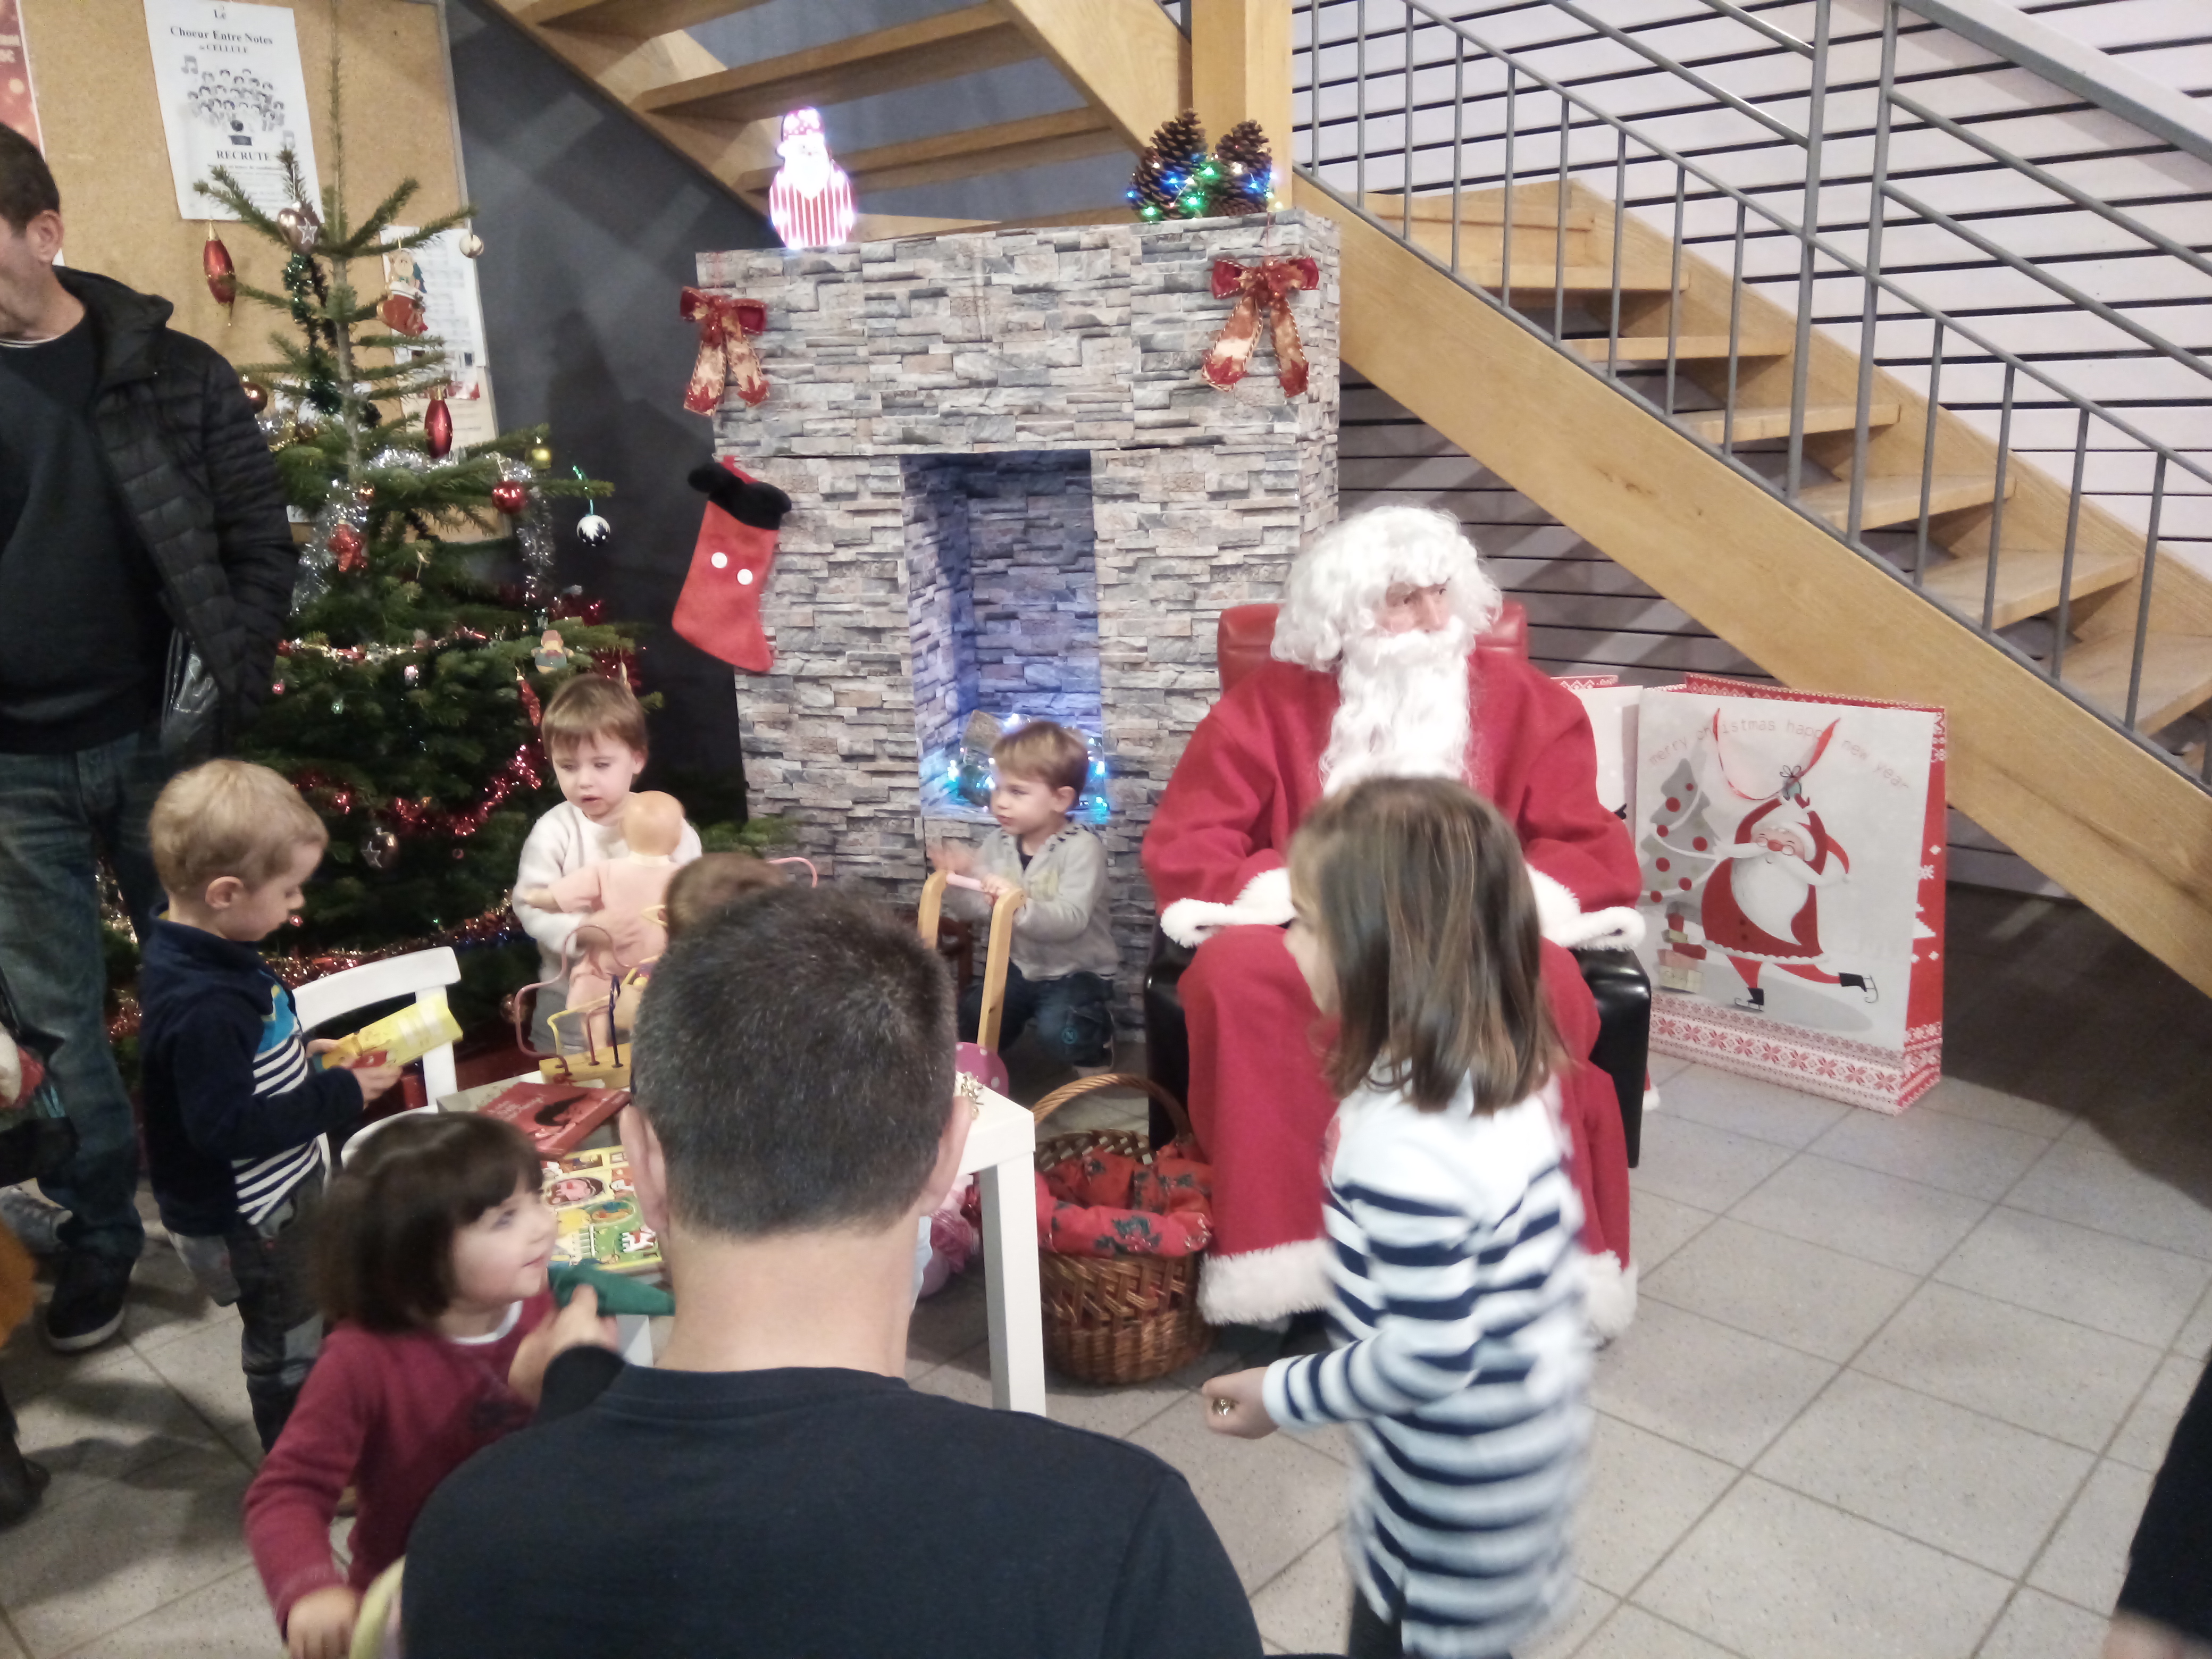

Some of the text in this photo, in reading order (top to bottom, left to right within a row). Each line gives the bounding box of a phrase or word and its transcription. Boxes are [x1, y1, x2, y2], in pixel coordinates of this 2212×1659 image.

[170, 26, 273, 45] Choeur Entre Notes
[217, 150, 269, 161] RECRUTE
[1649, 718, 1909, 789] merry chistmas happ new year
